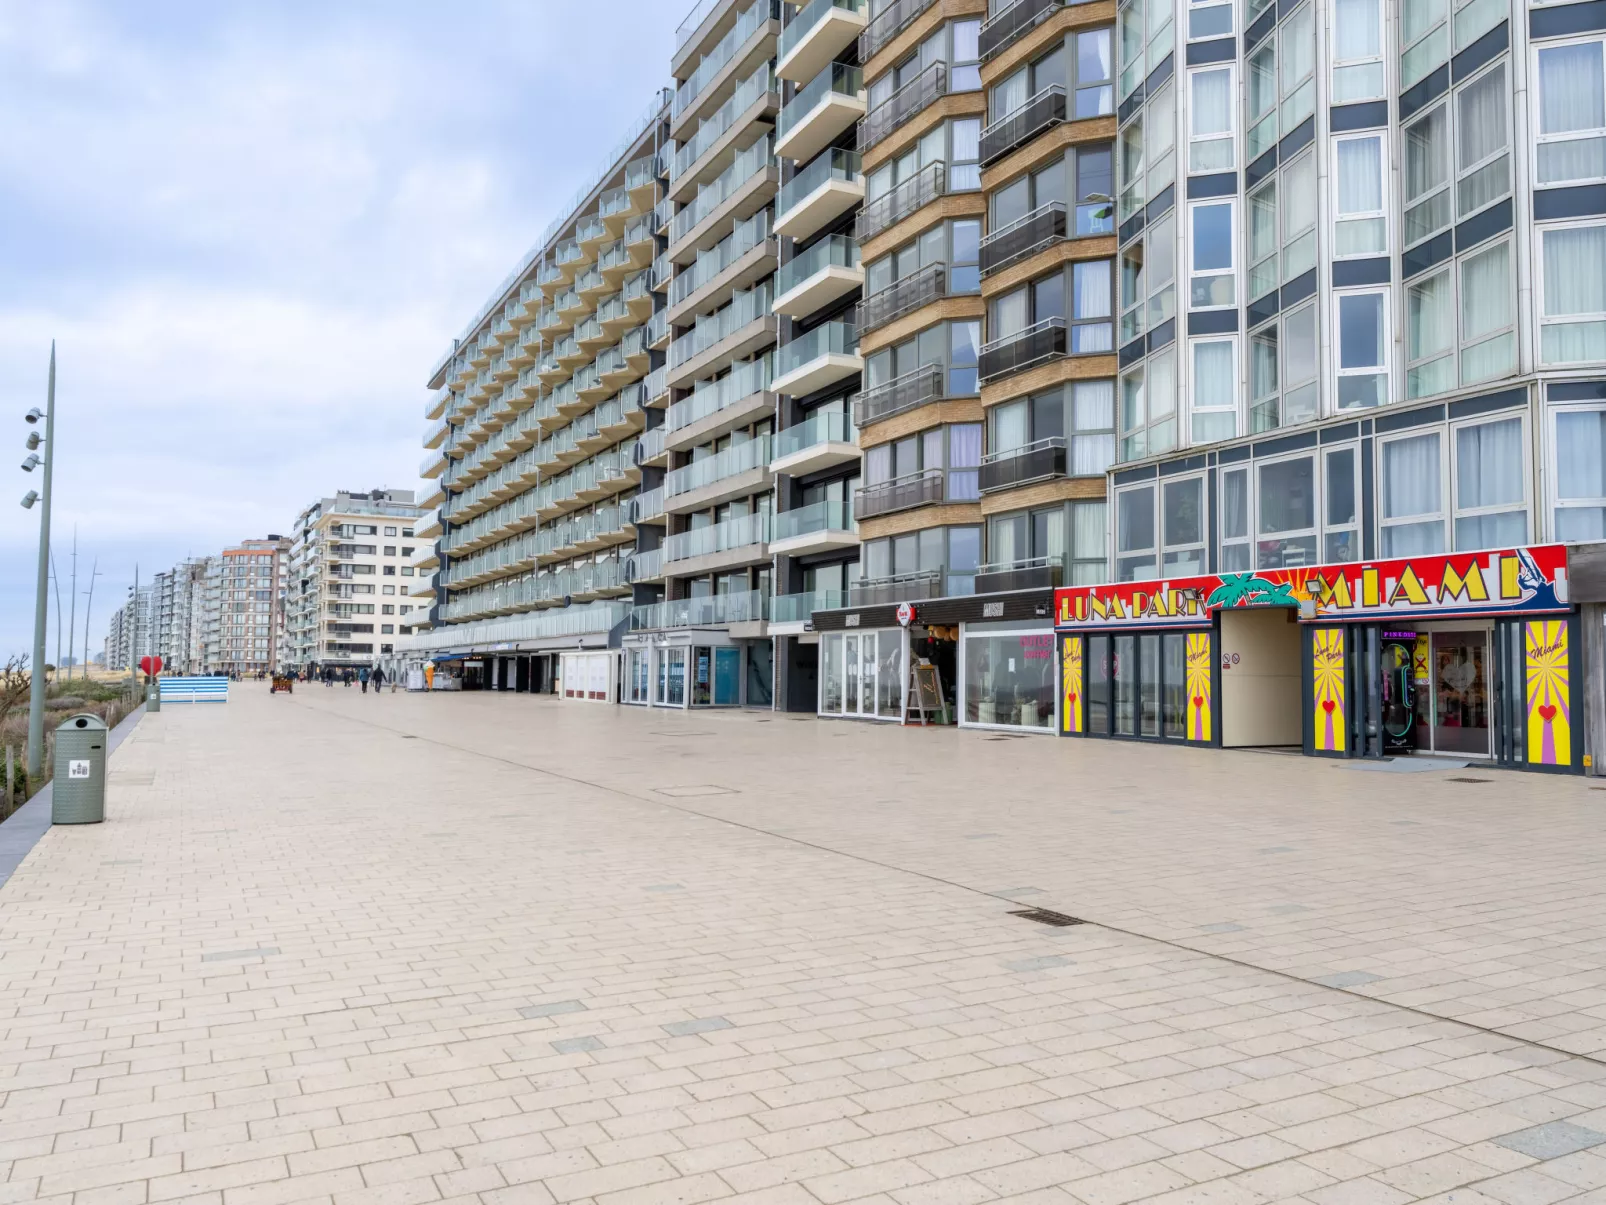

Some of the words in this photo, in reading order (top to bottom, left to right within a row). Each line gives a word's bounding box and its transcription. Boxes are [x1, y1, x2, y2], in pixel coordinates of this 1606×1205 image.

[1313, 555, 1523, 610] MIAMI
[1061, 592, 1127, 622] LUNA
[1132, 587, 1207, 618] PARK
[1019, 634, 1055, 647] OUTLET
[1531, 639, 1564, 660] Miami
